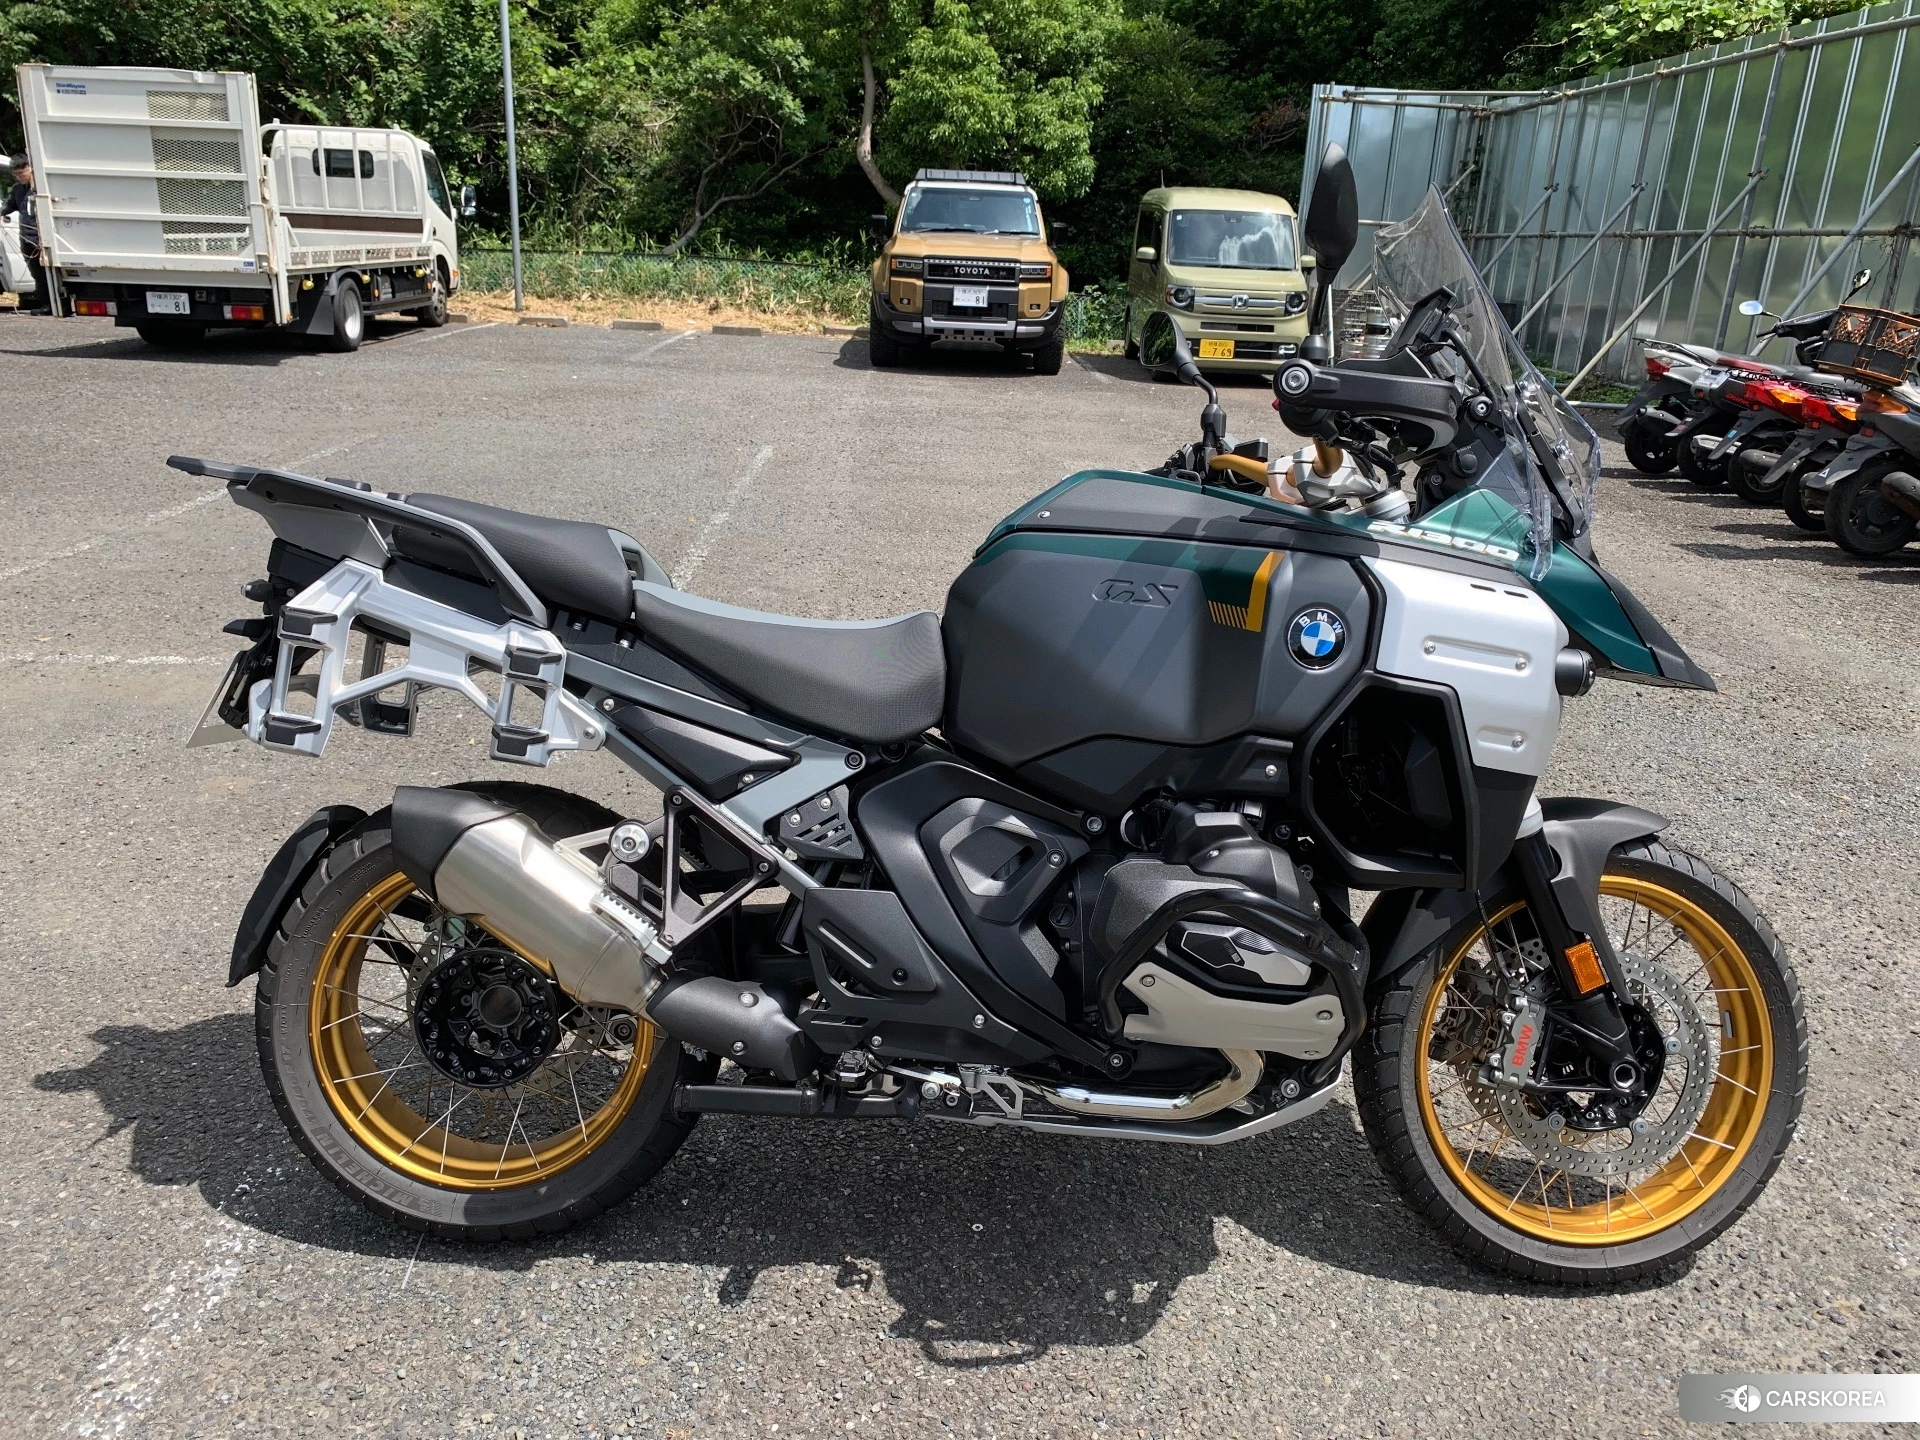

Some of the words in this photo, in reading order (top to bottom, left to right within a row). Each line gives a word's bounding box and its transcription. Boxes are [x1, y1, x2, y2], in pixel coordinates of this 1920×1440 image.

[953, 266, 990, 275] TOYOTA
[174, 301, 186, 312] 81
[976, 295, 985, 306] 81
[1092, 578, 1179, 608] GS
[1298, 611, 1344, 636] BMW
[1511, 1024, 1535, 1067] BMW
[316, 1131, 416, 1207] MICHELIN
